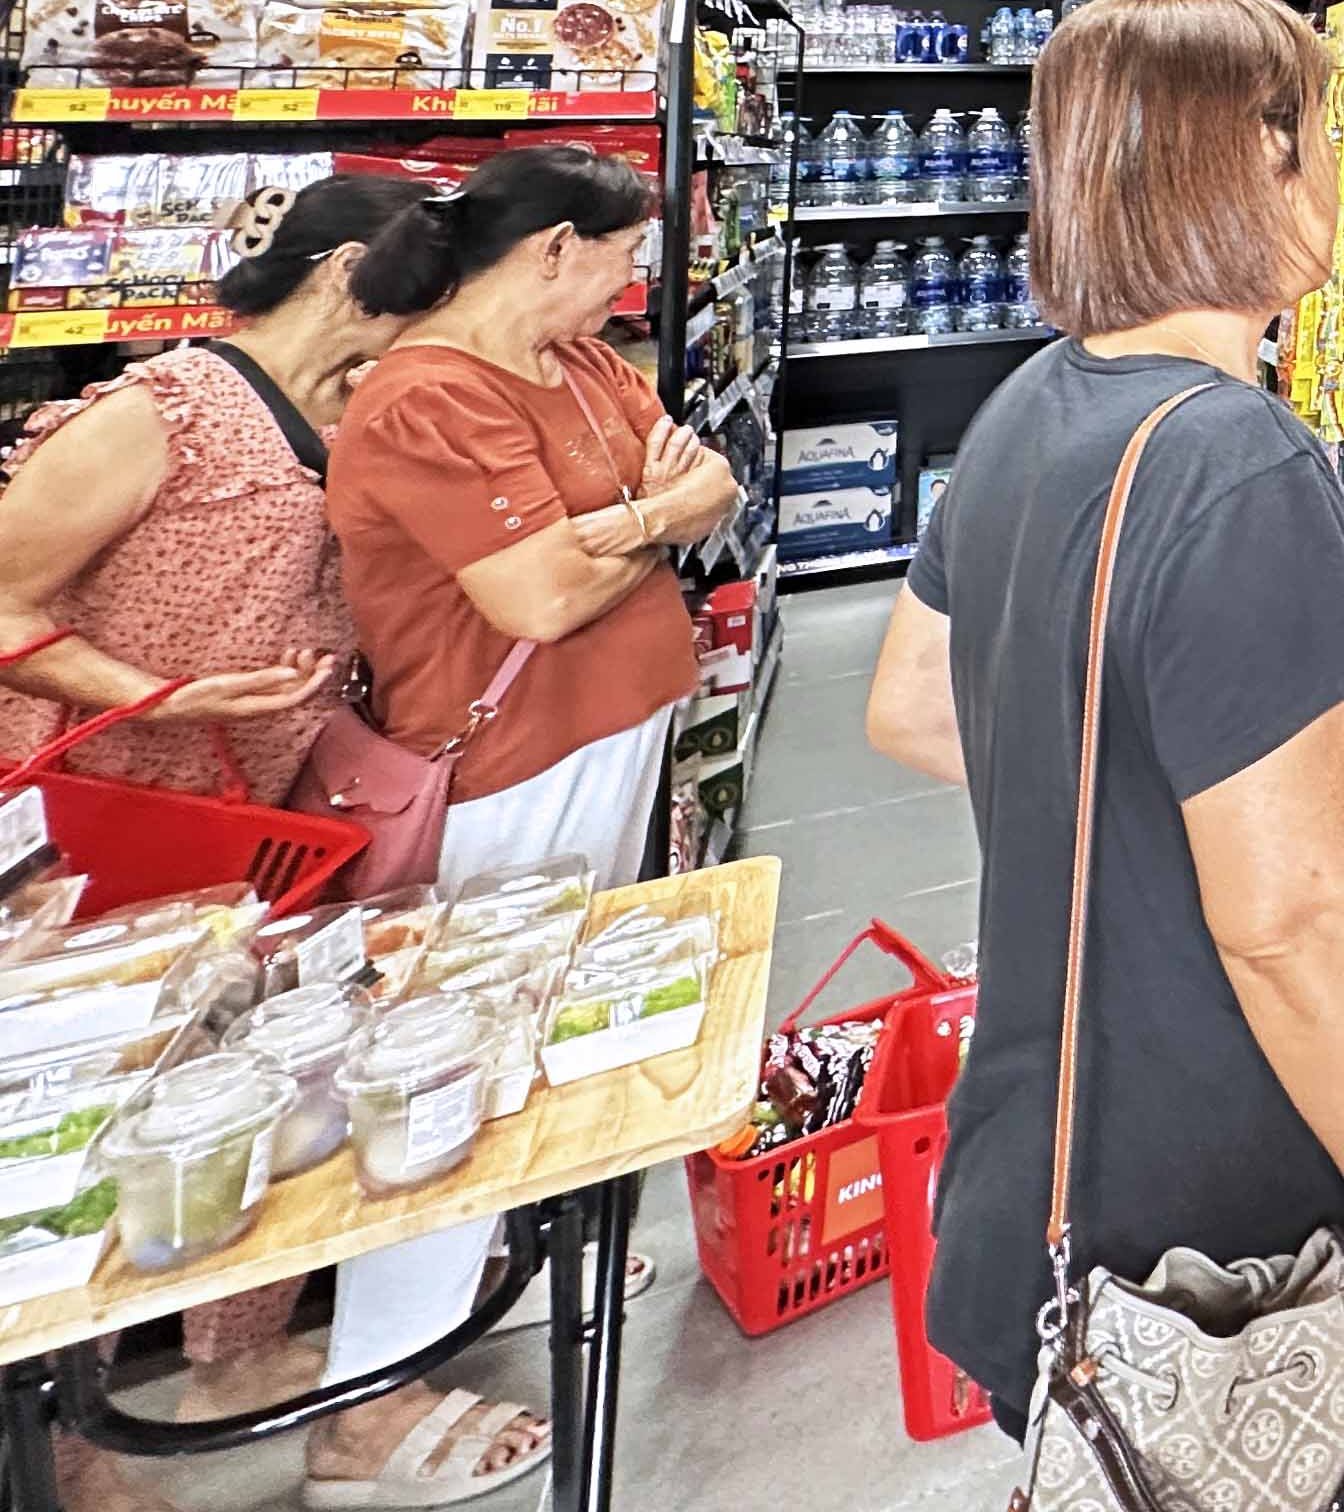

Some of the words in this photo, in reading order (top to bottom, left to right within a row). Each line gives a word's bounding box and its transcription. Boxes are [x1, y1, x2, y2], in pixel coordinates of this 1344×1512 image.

[109, 93, 192, 115] huyến
[798, 445, 856, 464] AQUAFINA
[793, 506, 852, 527] AQUAFINA
